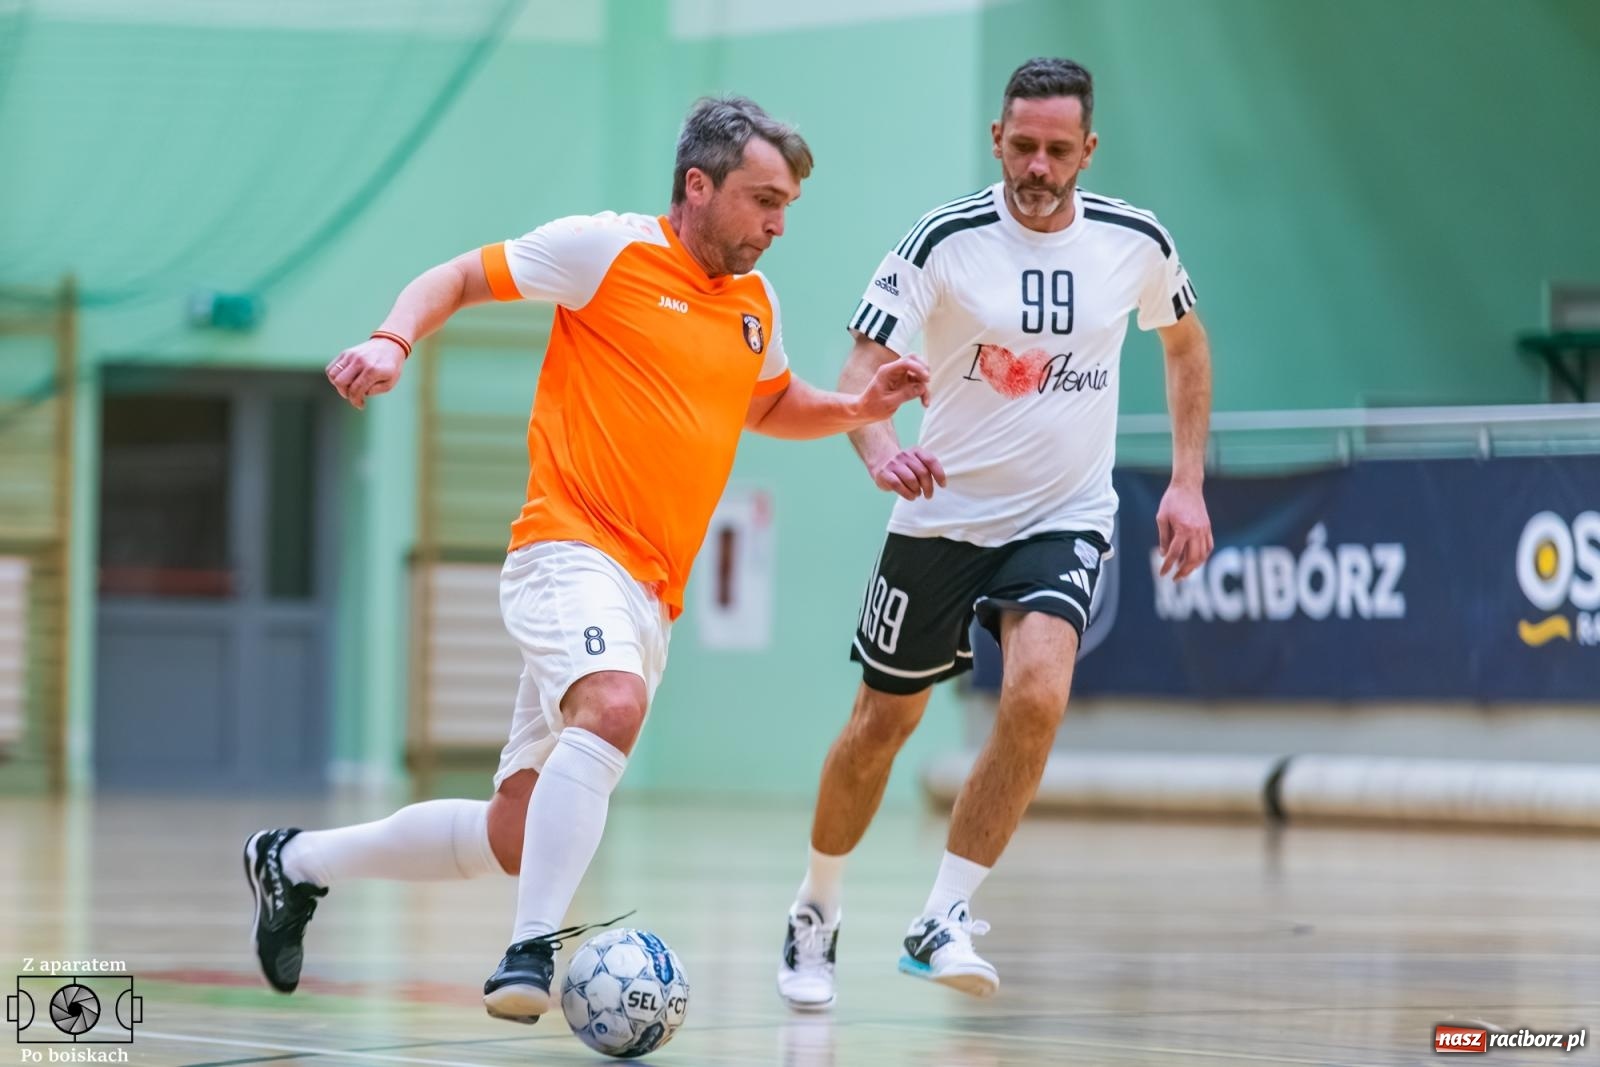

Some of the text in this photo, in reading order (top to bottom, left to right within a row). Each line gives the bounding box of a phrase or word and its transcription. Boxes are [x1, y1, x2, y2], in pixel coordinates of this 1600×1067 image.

[657, 295, 689, 313] JAKO
[1021, 269, 1075, 336] 99
[962, 343, 984, 382] I
[583, 625, 606, 656] 8
